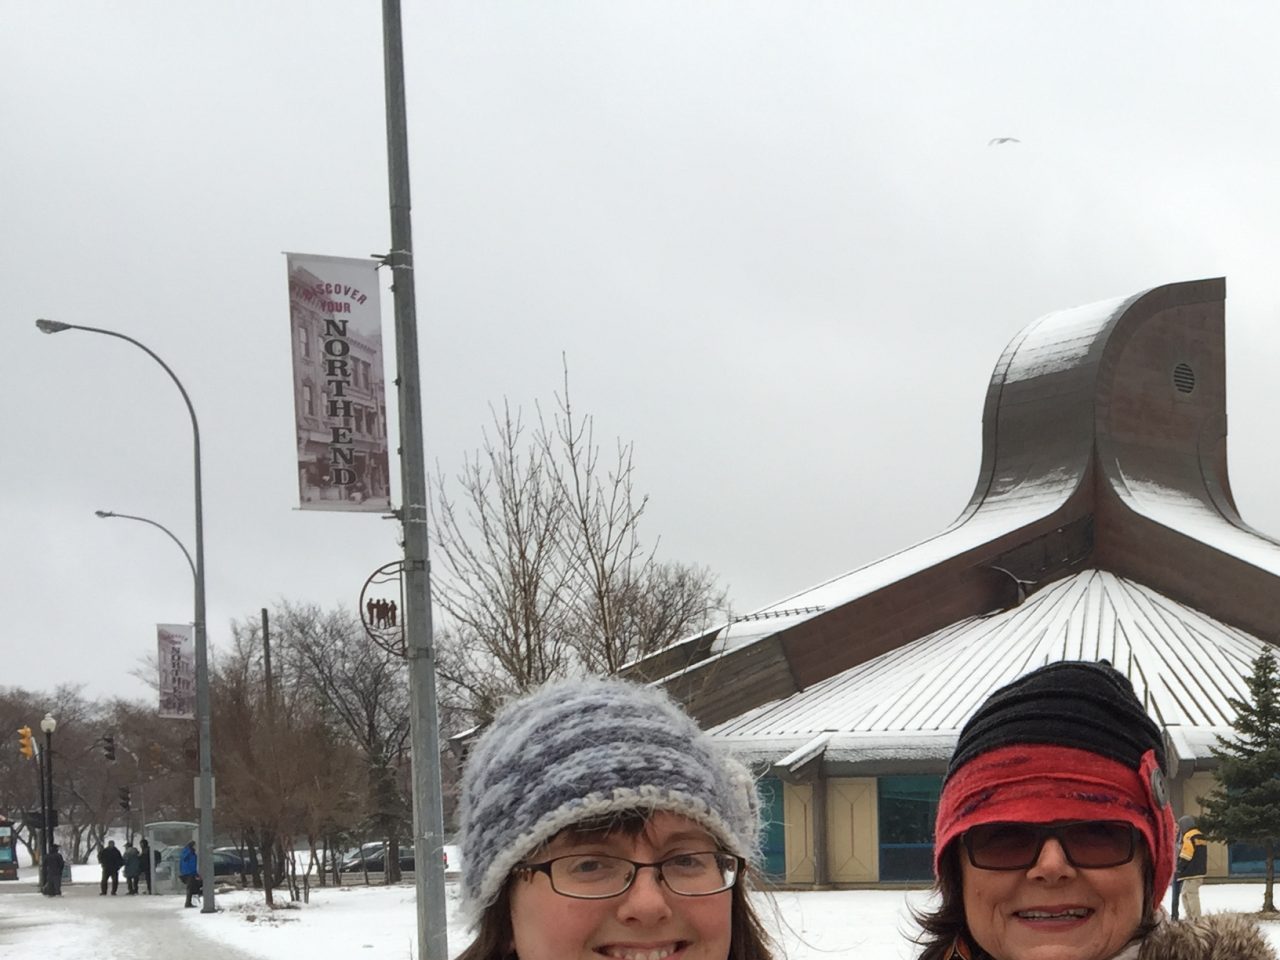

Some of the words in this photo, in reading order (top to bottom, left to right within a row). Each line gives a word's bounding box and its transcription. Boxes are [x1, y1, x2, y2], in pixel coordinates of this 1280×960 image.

[302, 283, 368, 305] DISCOVER
[320, 300, 351, 314] YOUR
[323, 319, 354, 418] NORTH
[330, 427, 357, 486] END
